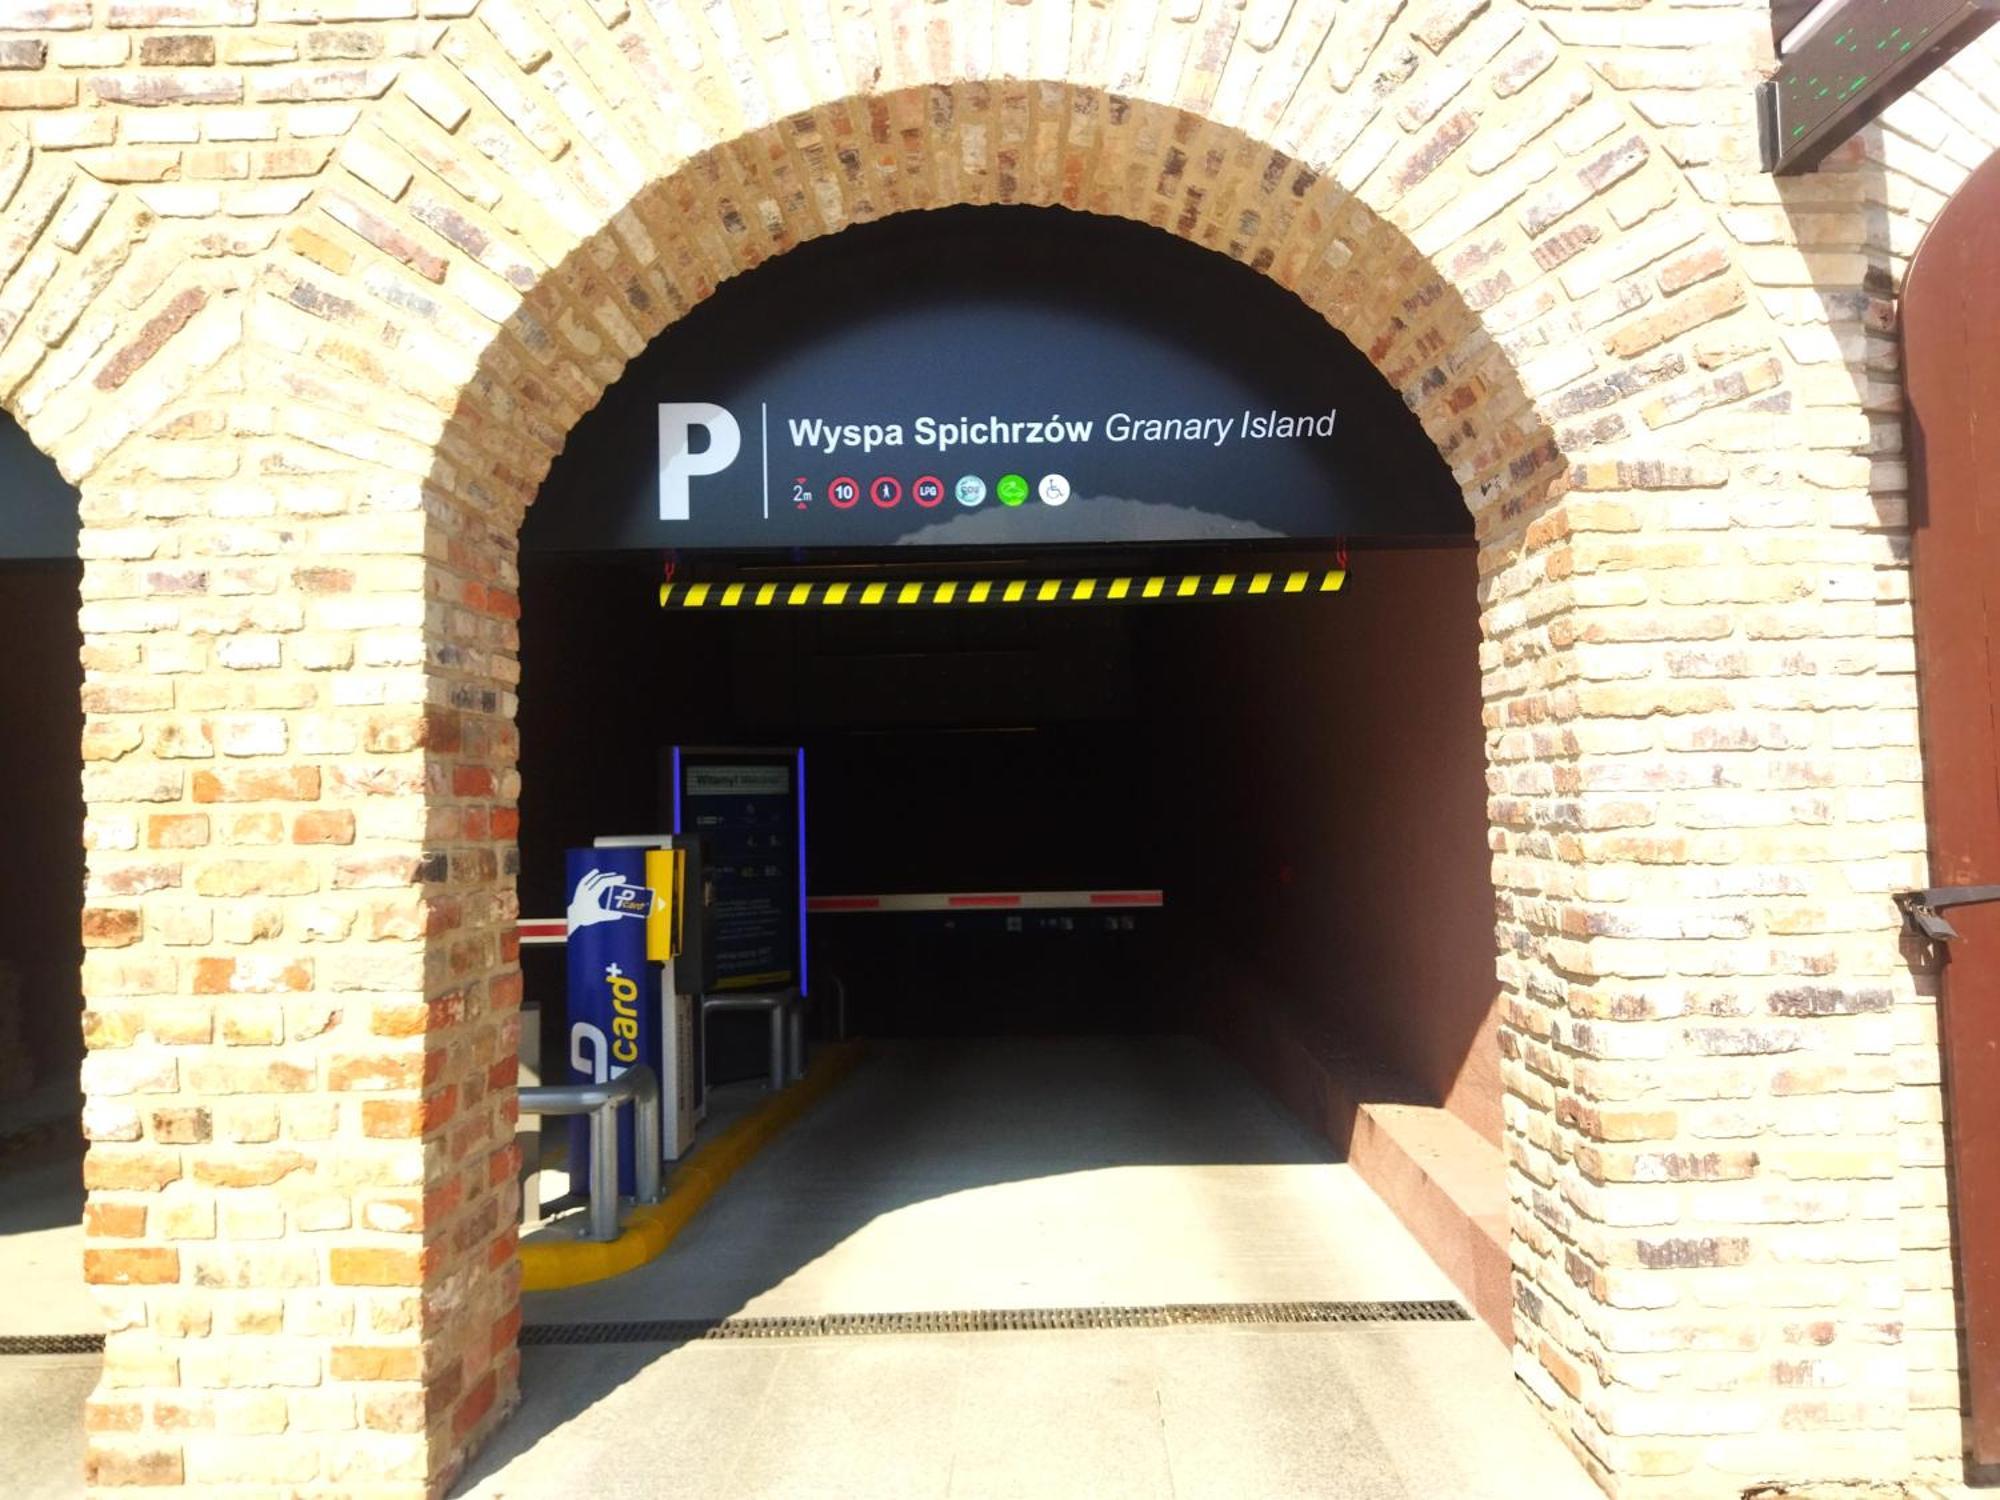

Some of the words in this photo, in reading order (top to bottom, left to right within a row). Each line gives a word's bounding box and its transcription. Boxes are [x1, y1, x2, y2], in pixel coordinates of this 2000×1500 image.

[788, 418, 904, 453] Wyspa
[914, 414, 1094, 452] Spichrzów
[1105, 412, 1234, 447] Granary
[1240, 409, 1337, 439] Island
[658, 402, 742, 521] P
[834, 485, 853, 499] 10
[919, 486, 937, 497] LPG
